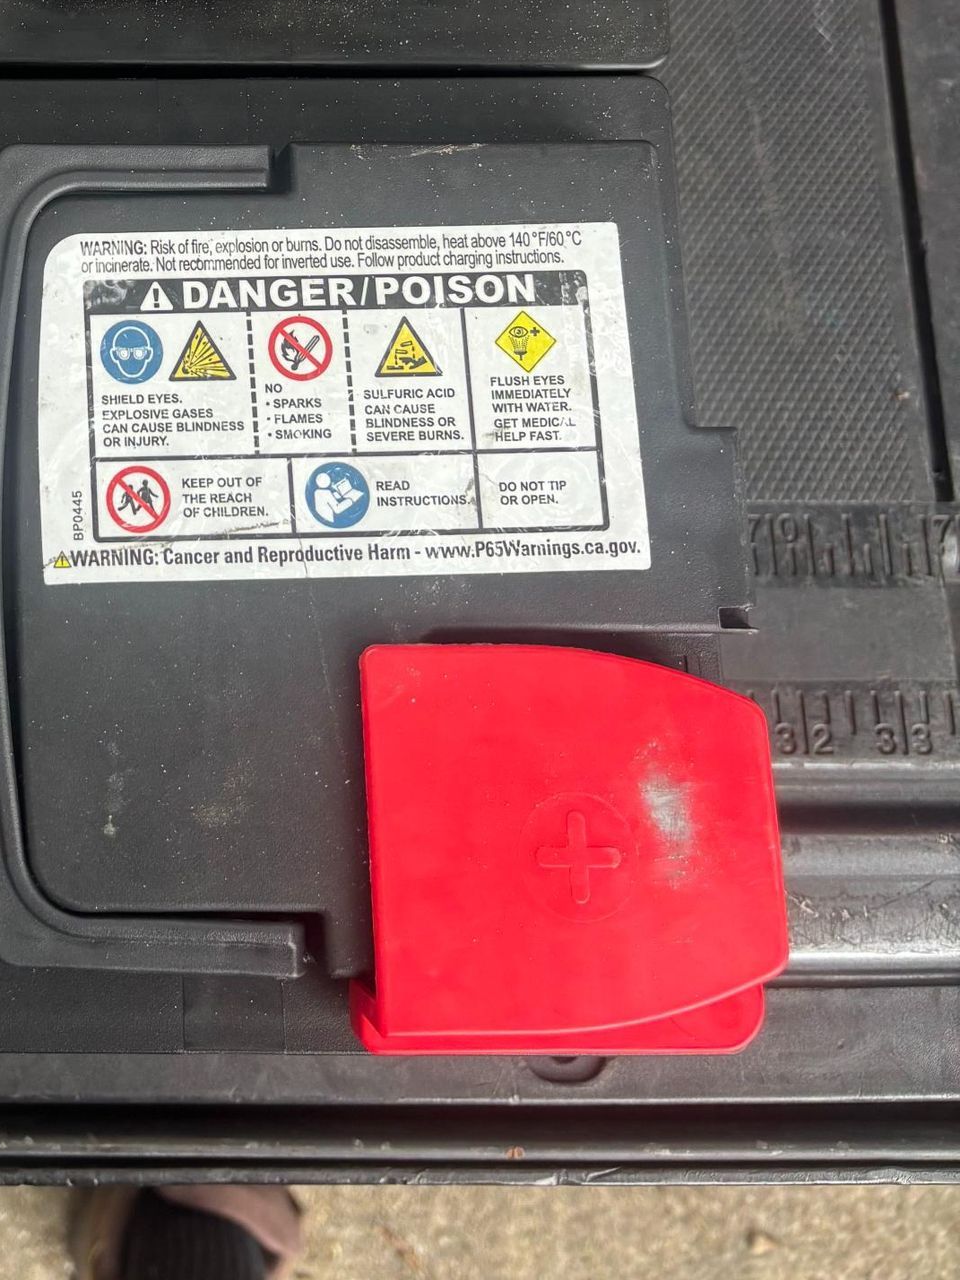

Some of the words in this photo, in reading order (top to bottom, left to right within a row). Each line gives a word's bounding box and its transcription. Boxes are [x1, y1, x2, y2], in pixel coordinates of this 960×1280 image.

[80, 240, 147, 256] WARNING:
[150, 240, 175, 254] Risk
[178, 240, 189, 254] of
[192, 239, 213, 256] fire,
[215, 239, 269, 256] explosion
[272, 242, 283, 253] or
[286, 238, 322, 253] burns.
[325, 237, 341, 251] Do
[344, 237, 362, 250] not
[365, 234, 441, 251] disassemble,
[442, 235, 469, 248] heat
[472, 234, 506, 248] above
[183, 273, 535, 308] DANGER/POISON
[490, 375, 530, 387] FLUSH
[533, 375, 565, 386] EYES
[265, 383, 282, 393] NO
[491, 387, 571, 400] IMMEDIATELY
[102, 393, 144, 406] SHIELD
[148, 393, 182, 405] EYES.
[274, 398, 322, 409] SPARKS
[492, 401, 522, 414] WITH
[525, 400, 572, 413] WATER.
[102, 408, 169, 421] EXPLOSIVE
[172, 407, 213, 419] GASES
[274, 412, 323, 425] FLAMES
[103, 421, 129, 434] CAN
[132, 421, 173, 433] CAUSE
[176, 420, 245, 432] BLINDNESS
[494, 417, 519, 428] GET
[275, 428, 331, 440] SMOKING
[496, 430, 527, 442] HELP
[530, 429, 562, 442] FAST.
[103, 435, 121, 447] OR
[124, 435, 169, 447] INJURY.
[376, 480, 410, 492] READ
[499, 481, 517, 492] DO
[520, 481, 545, 492] NOT
[548, 480, 567, 491] TIP
[377, 494, 472, 507] INSTRUCTIONS.
[500, 494, 519, 505] OR
[522, 493, 558, 506] OPEN.
[73, 490, 83, 541] BP0445
[70, 549, 160, 568] WARNING:
[163, 547, 220, 565] Cancer
[224, 546, 253, 565] and
[258, 545, 363, 565] Reproductive
[368, 543, 411, 561] Harm
[425, 539, 641, 560] www.P65Warnings.ca.gov.
